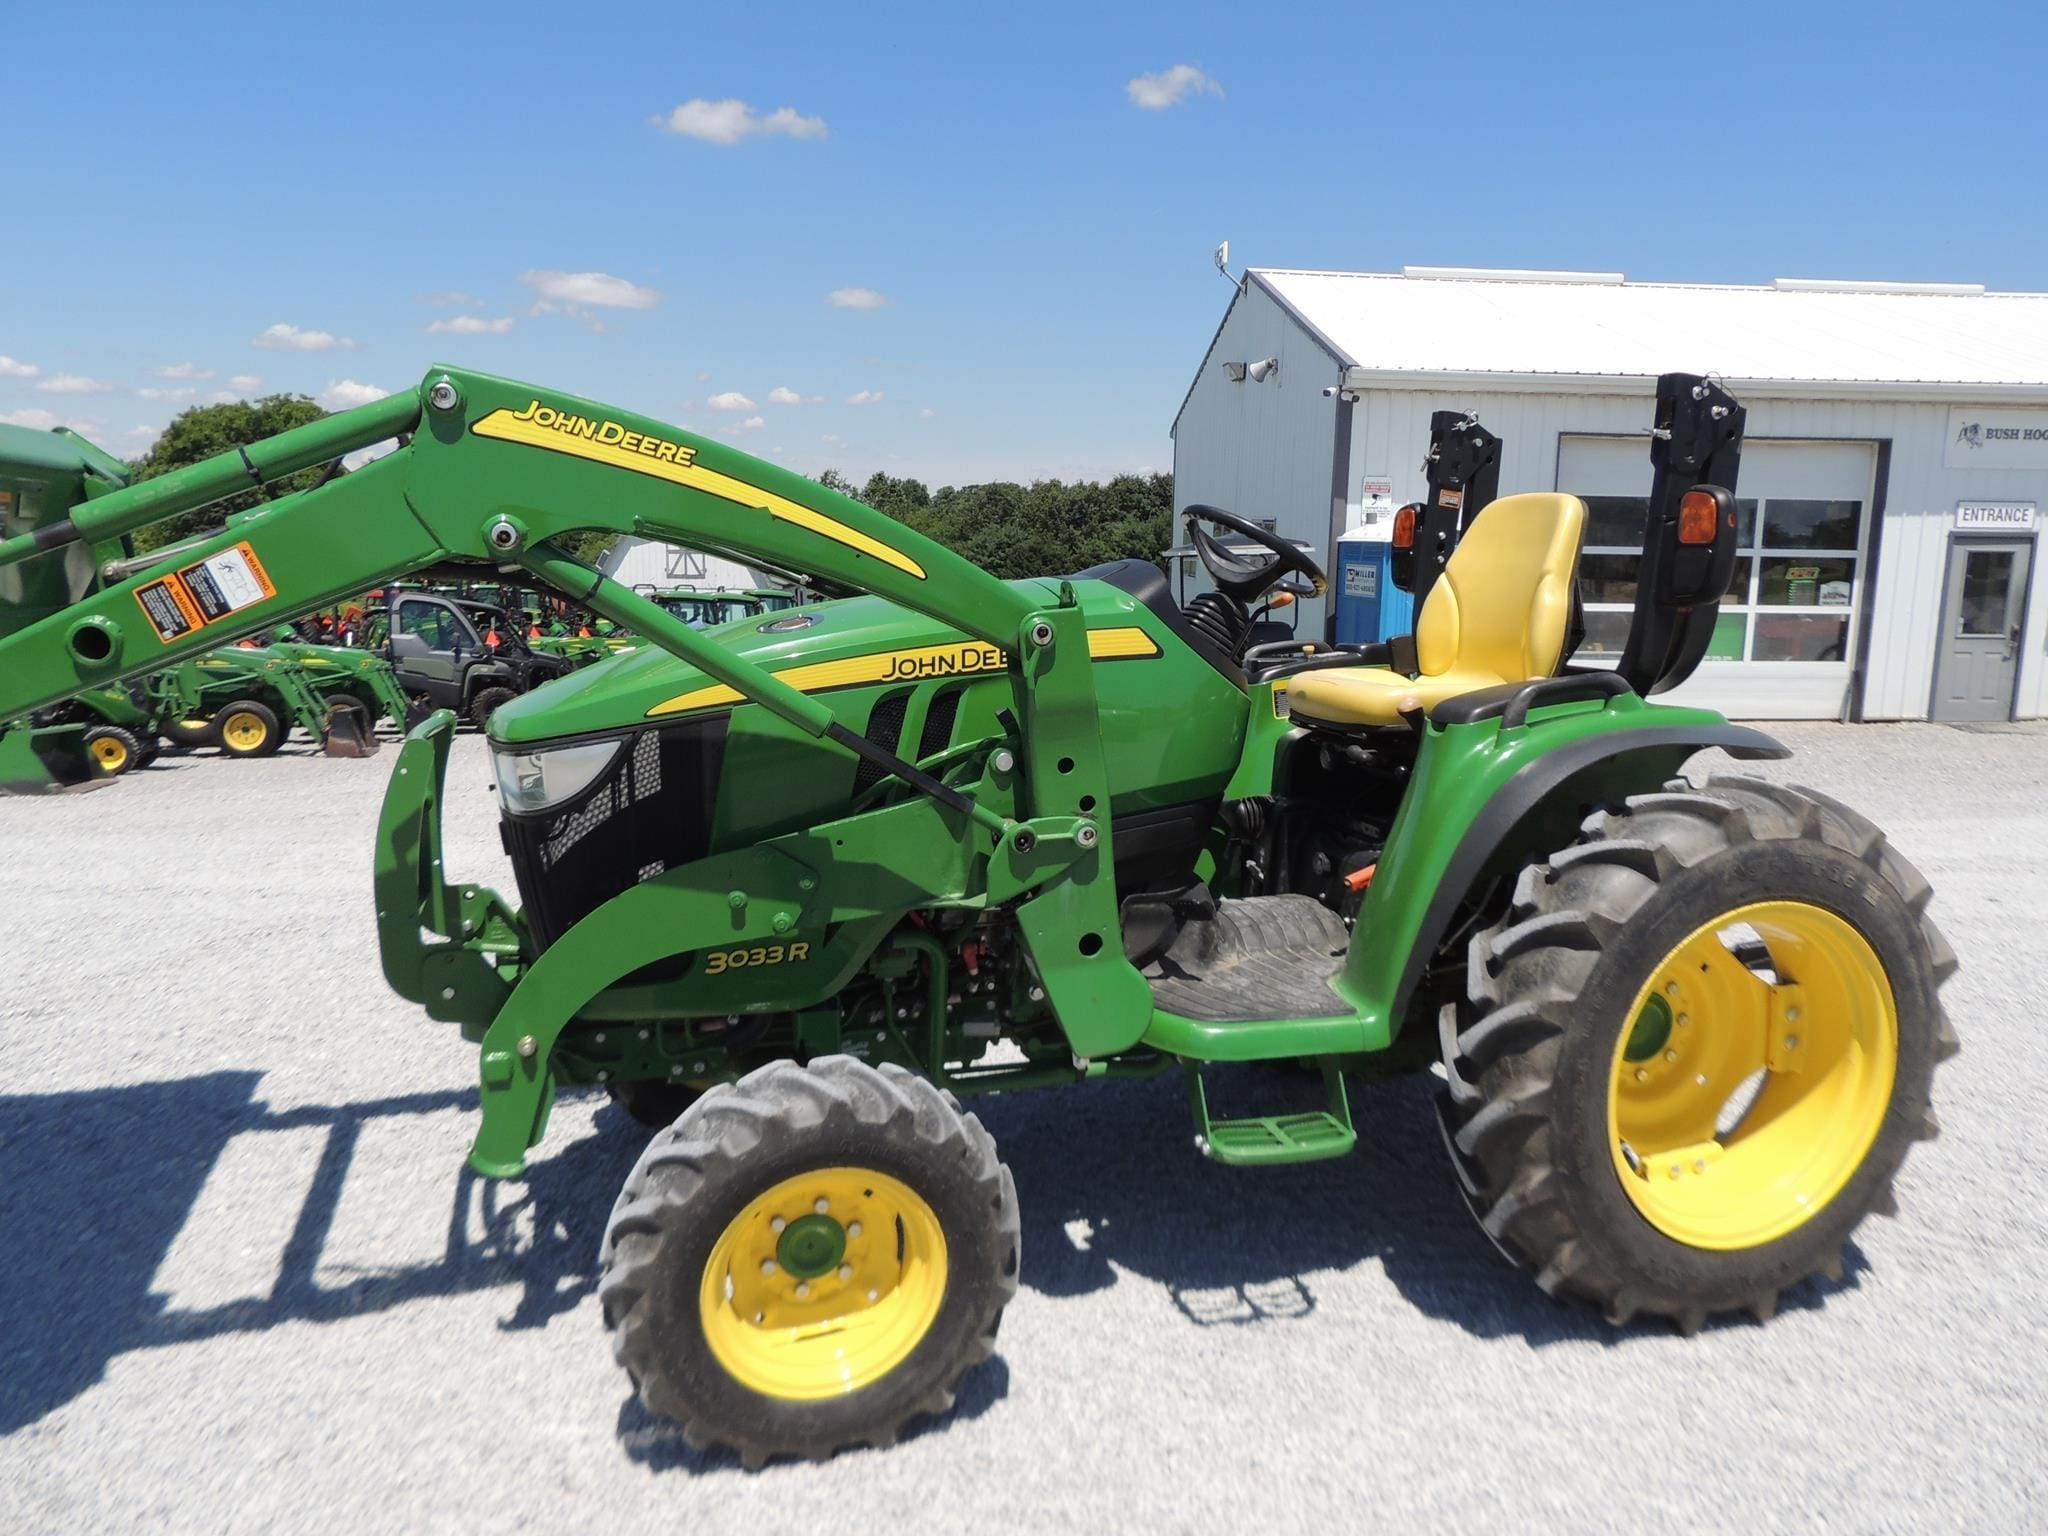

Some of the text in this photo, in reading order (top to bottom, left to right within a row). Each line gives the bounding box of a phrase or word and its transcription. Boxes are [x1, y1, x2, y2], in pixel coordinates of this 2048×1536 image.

[513, 400, 697, 467] JOHN DEERE
[1986, 428, 2020, 440] BUSH
[1962, 507, 2029, 522] ENTRANCE
[247, 556, 270, 592] WARNING
[174, 590, 197, 625] WARNING
[882, 648, 1008, 679] JOHN DEE
